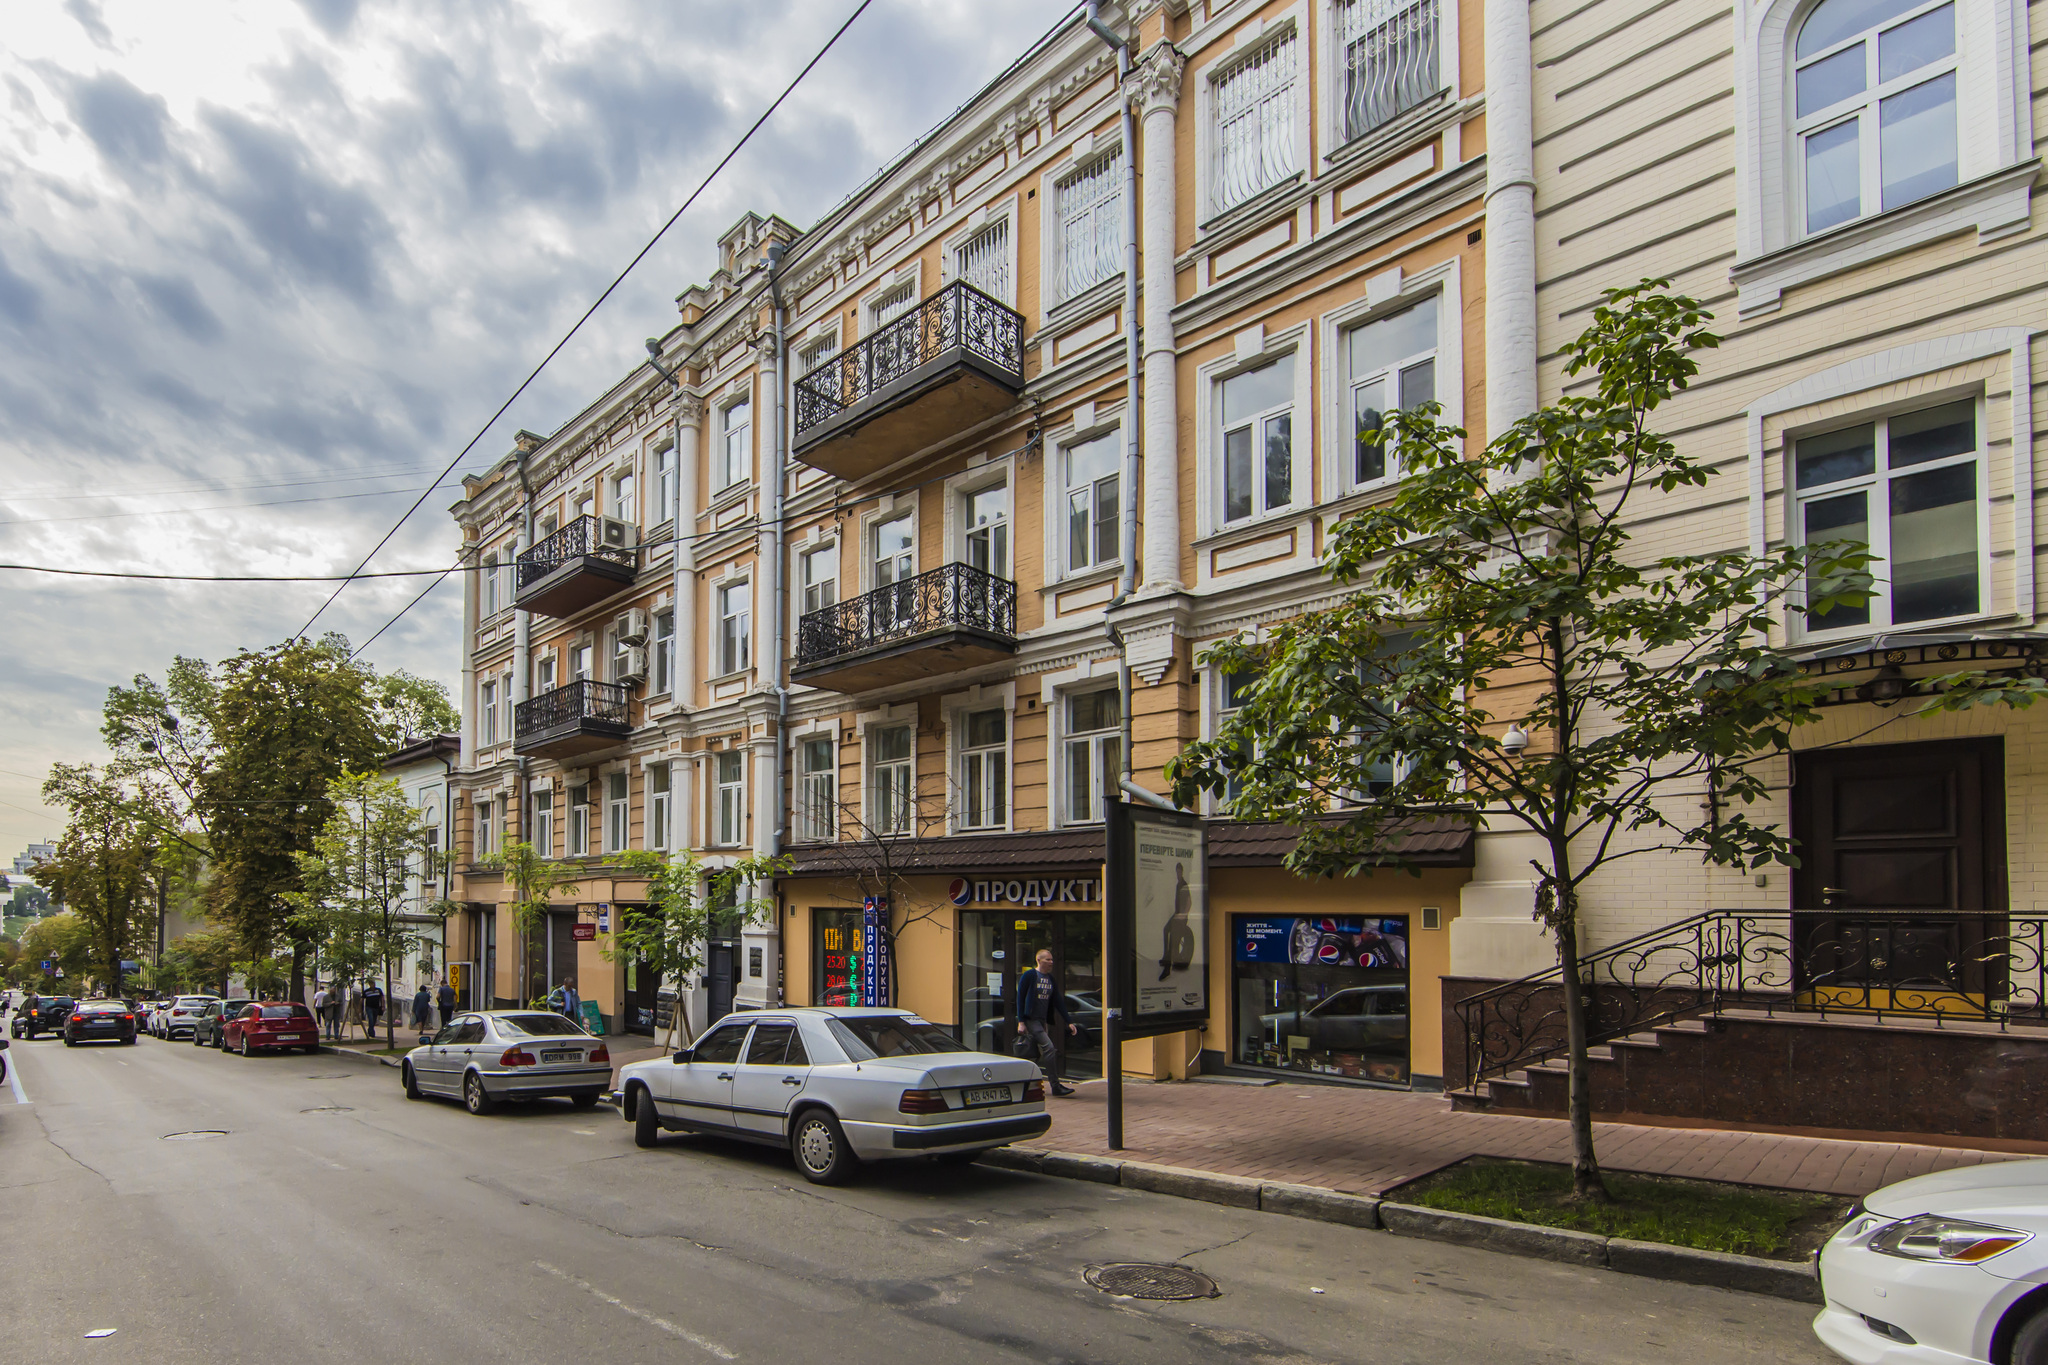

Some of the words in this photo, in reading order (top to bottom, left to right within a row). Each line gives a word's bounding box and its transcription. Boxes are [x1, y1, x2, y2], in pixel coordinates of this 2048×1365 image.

[1140, 844, 1174, 857] ПЕРЕВІРТЕ
[1175, 847, 1194, 859] ШИНИ
[866, 925, 874, 1005] ПРОДУКТИ
[982, 1090, 997, 1100] 4947
